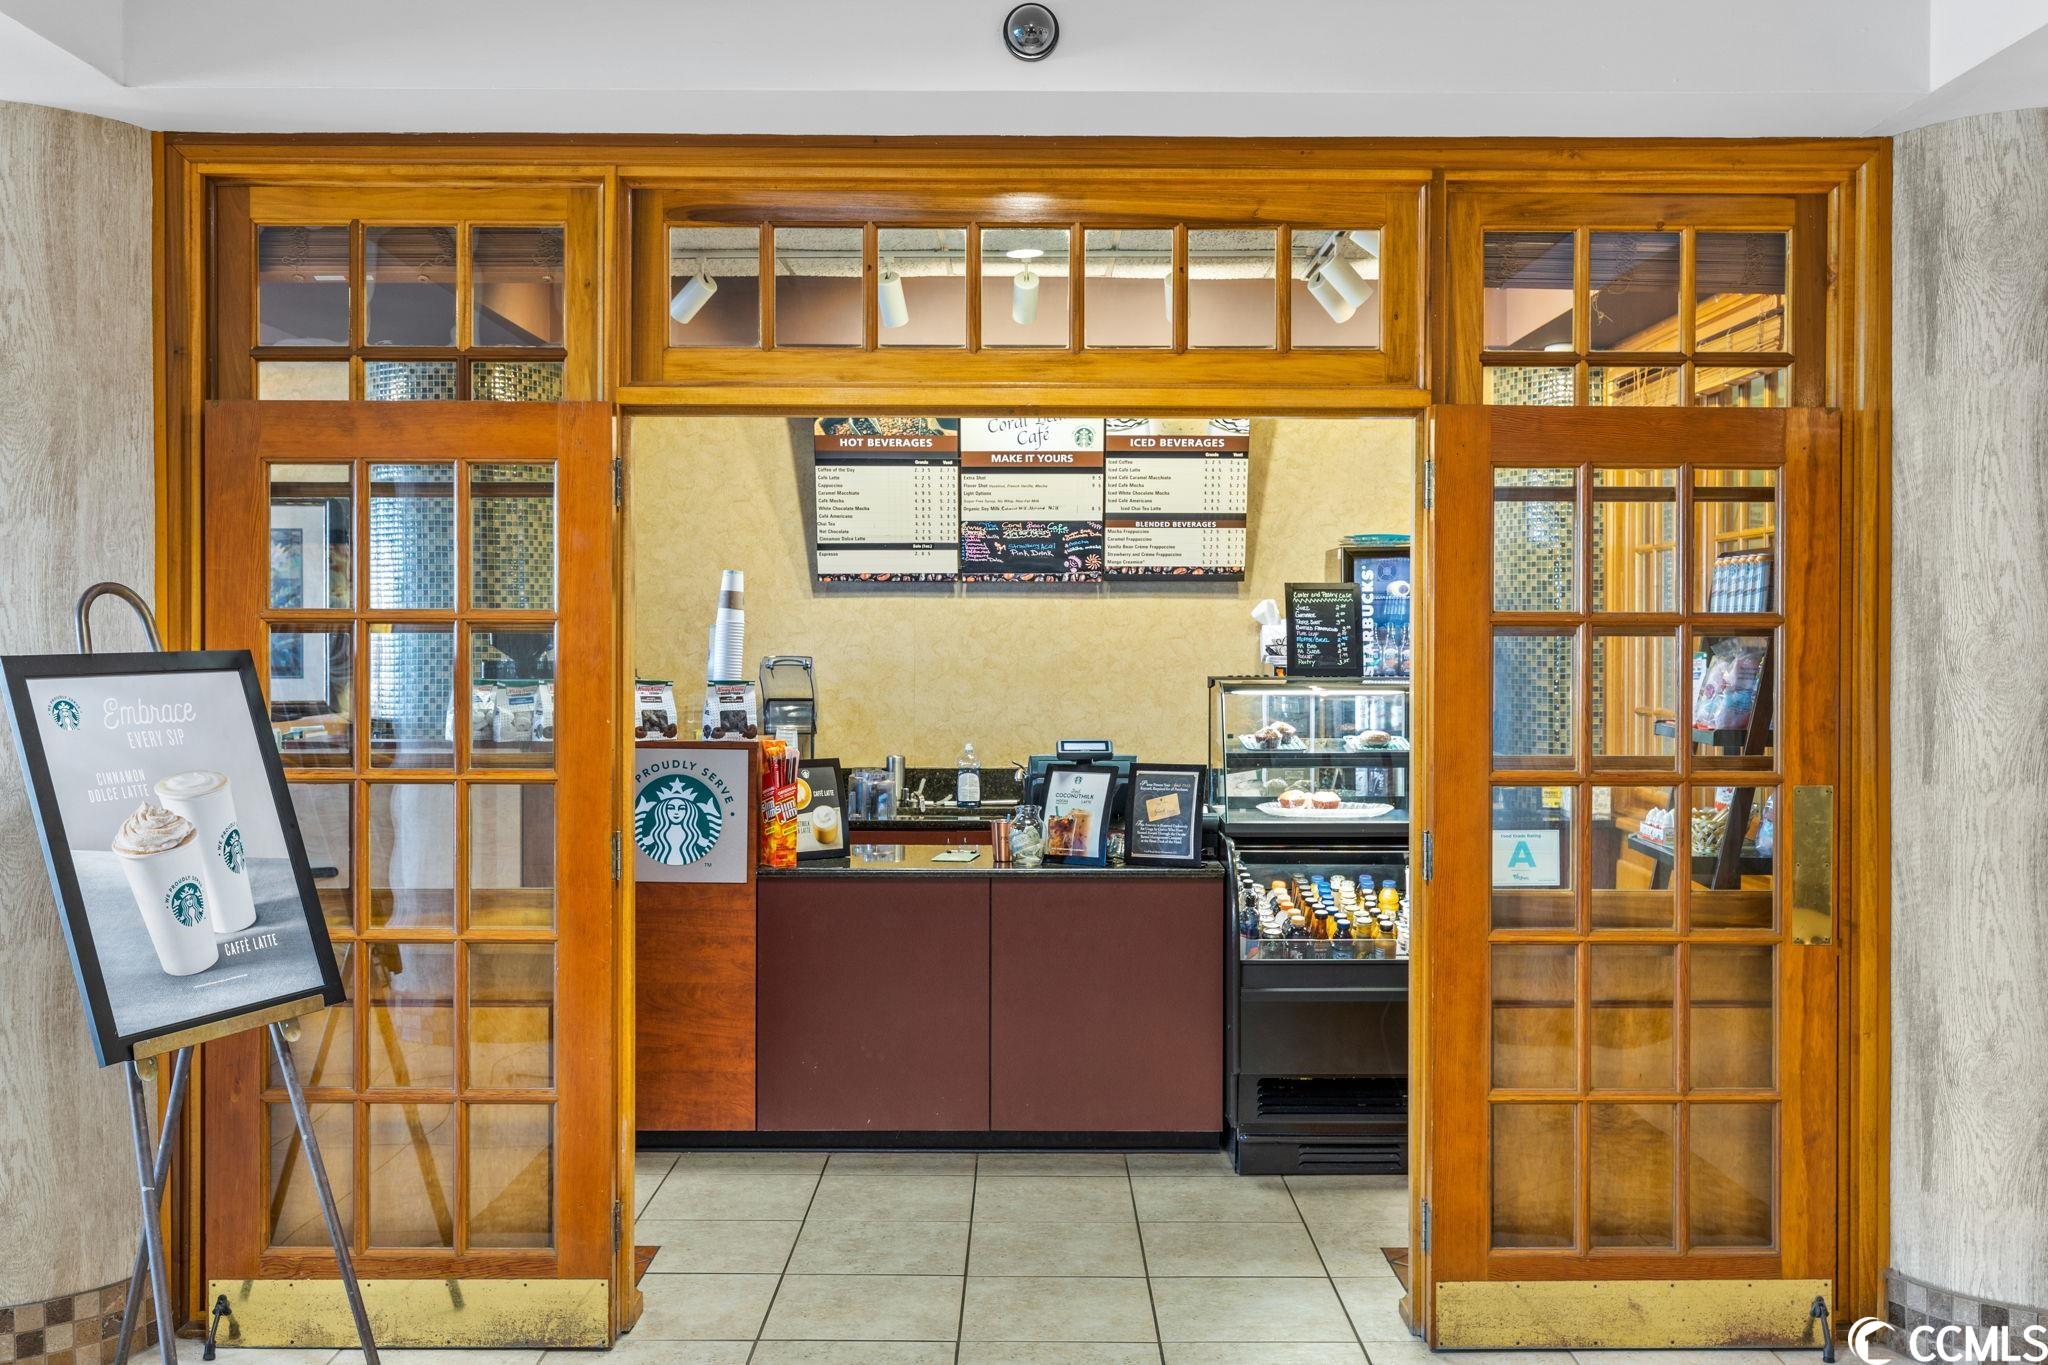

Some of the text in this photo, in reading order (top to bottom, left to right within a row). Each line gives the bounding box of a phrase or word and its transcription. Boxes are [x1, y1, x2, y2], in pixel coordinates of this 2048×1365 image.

[840, 438, 933, 447] HOT BEVERAGES
[1017, 424, 1050, 450] Café
[1130, 438, 1225, 447] ICED BEVERAGES
[991, 454, 1074, 463] MAKE IT YOURS
[1361, 569, 1374, 677] STARBUCKS
[103, 697, 196, 730] Embrace
[127, 728, 184, 749] EVERY SIP
[95, 768, 146, 786] CINNAMON
[635, 759, 734, 804] PROUDLY SERVE
[87, 783, 150, 803] DOLCE LATTE
[1055, 792, 1095, 800] COCONUTMILK
[1508, 841, 1536, 868] A
[165, 893, 171, 903] WE
[224, 933, 278, 956] CAFFÈ LATTE
